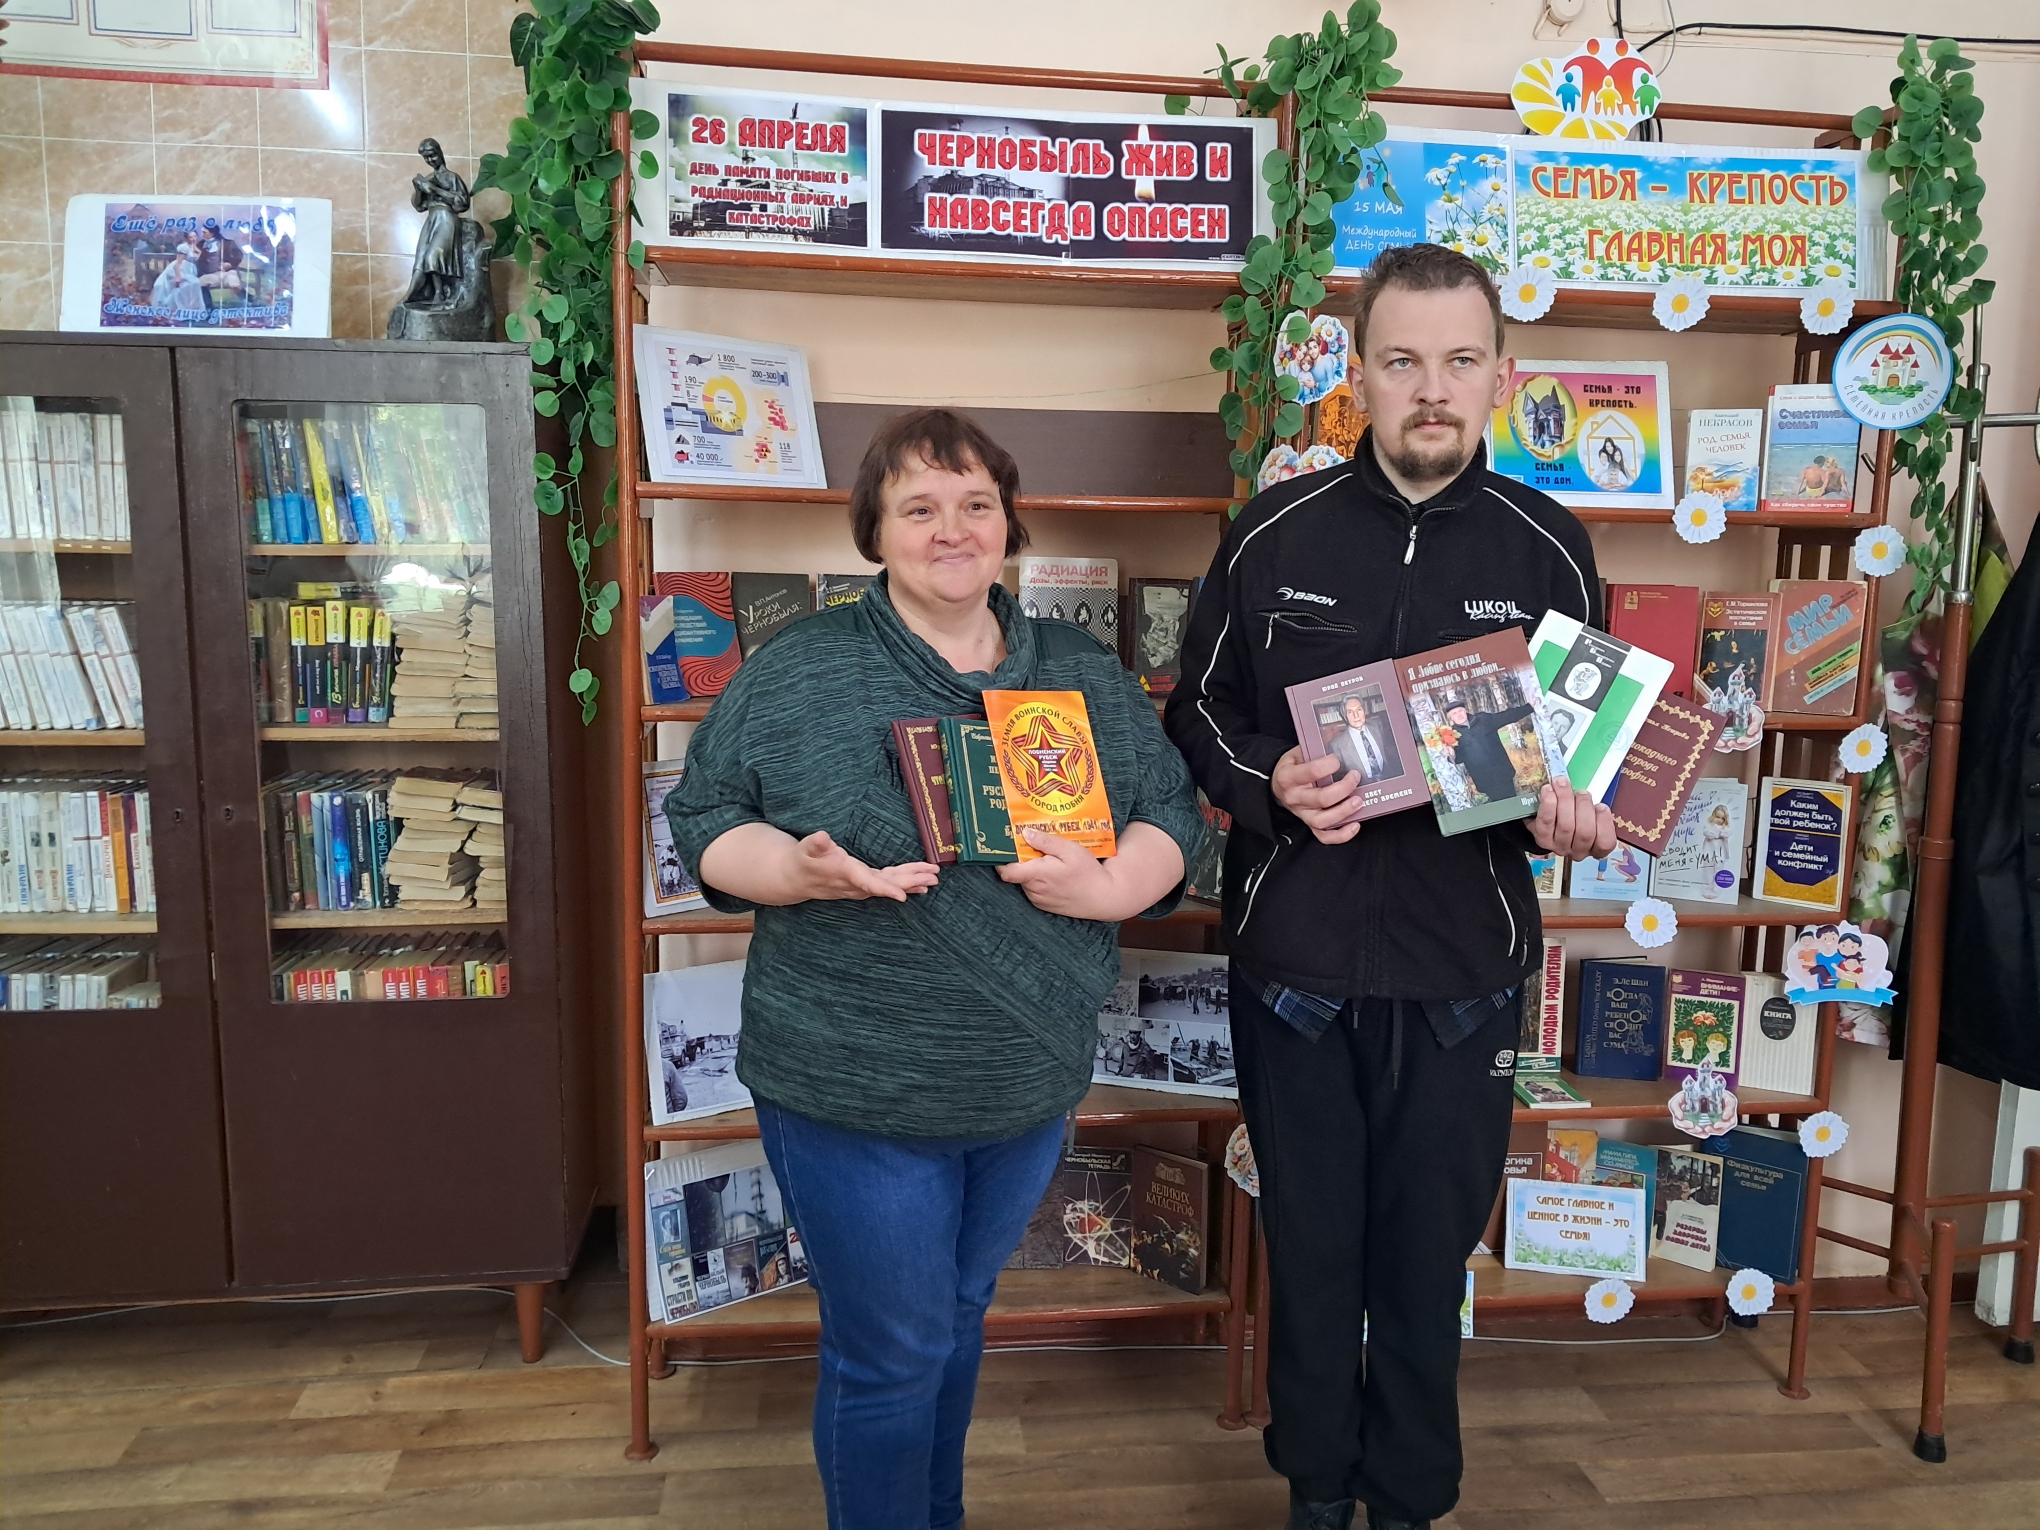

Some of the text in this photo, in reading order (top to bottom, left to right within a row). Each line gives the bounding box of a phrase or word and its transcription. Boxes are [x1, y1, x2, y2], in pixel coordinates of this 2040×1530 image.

[692, 117, 846, 153] 26 АПРЕЛЯ
[917, 131, 1229, 179] ЧЕРНОБЫЛЬ ЖИВ И
[689, 162, 849, 185] ДЕНЬ ПАМЯТИ ПОГИБШИХ В
[1531, 165, 1848, 206] СЕМЬЯ КРЕПОСТЬ
[690, 185, 786, 204] РАДИАЦИОННЫХ
[839, 195, 848, 207] И
[1354, 201, 1403, 215] 15 МАЯ
[110, 214, 217, 234] Ещё раз о
[728, 211, 812, 228] КАТАСТРОФАХ
[927, 195, 1228, 242] НАВСЕГДА ОПАСЕН
[1341, 224, 1418, 239] Международный
[1344, 239, 1375, 252] ДЕНЬ
[1587, 229, 1807, 266] ГЛАВНАЯ МОЯ
[723, 355, 736, 363] 800
[684, 375, 697, 384] 190
[1583, 384, 1641, 394] СЕМЬЯ ЭТО
[1891, 389, 1939, 420] КРЕПОСТЬ
[1778, 408, 1852, 420] Счастлив
[1699, 418, 1753, 427] НЕКРАСОВ
[693, 435, 706, 444] 700
[779, 442, 791, 450] 118
[1706, 442, 1746, 454] ЧЕЛОВЕК
[1535, 462, 1565, 472] СЕМЬЯ
[1535, 476, 1550, 485] ЭТО
[1030, 564, 1109, 579] РАДИАЦИЯ
[826, 589, 866, 606] ЧЕРНОБ
[1464, 599, 1522, 614] LUKOIL
[1786, 594, 1834, 633] МИР
[1784, 603, 1854, 656] СЕМЬИ
[1407, 653, 1481, 681] Я Лобне сегодня
[1412, 675, 1461, 694] признаюсь
[1001, 706, 1087, 747] ЗЕМЛЯ ВОИНСКОЙ СЛАВЫ
[1630, 742, 1678, 766] локадного
[1626, 753, 1660, 772] города
[1621, 766, 1657, 787] рофиль
[1030, 794, 1085, 813] ГОРОД ЛОБНЯ
[1789, 799, 1819, 811] Каким
[1774, 808, 1834, 822] должен быть
[1770, 816, 1838, 831] твой ребенок?
[377, 820, 389, 867] СТИНОВА
[1789, 841, 1814, 852] Дети
[1658, 857, 1687, 870] МЕНЯ
[1777, 857, 1824, 872] конфликт
[1780, 850, 1829, 864] семейный
[1541, 945, 1563, 1055] МОЛОДЫМ РОДИТЕЛЯМ
[1606, 987, 1639, 1002] КОГДА
[1610, 1001, 1628, 1009] ВАШ
[1604, 1009, 1648, 1024] РЕБЕНОК
[1763, 1010, 1793, 1020] КНИГА
[1604, 1019, 1643, 1034] СВОДИТ
[1608, 1031, 1623, 1040] ВАС
[1504, 1156, 1533, 1166] огика
[1503, 1166, 1528, 1175] овья
[1726, 1159, 1784, 1179] Физкультура
[1753, 1172, 1775, 1185] всей
[1151, 1181, 1190, 1205] ВЕЛИКИХ
[1145, 1191, 1195, 1218] КАТАСТРОФ
[1536, 1195, 1615, 1211] САМОЕ ГЛАВНОЕ И
[1526, 1210, 1630, 1229] ЦЕННОЕ В ЖИЗНИ ЭТО
